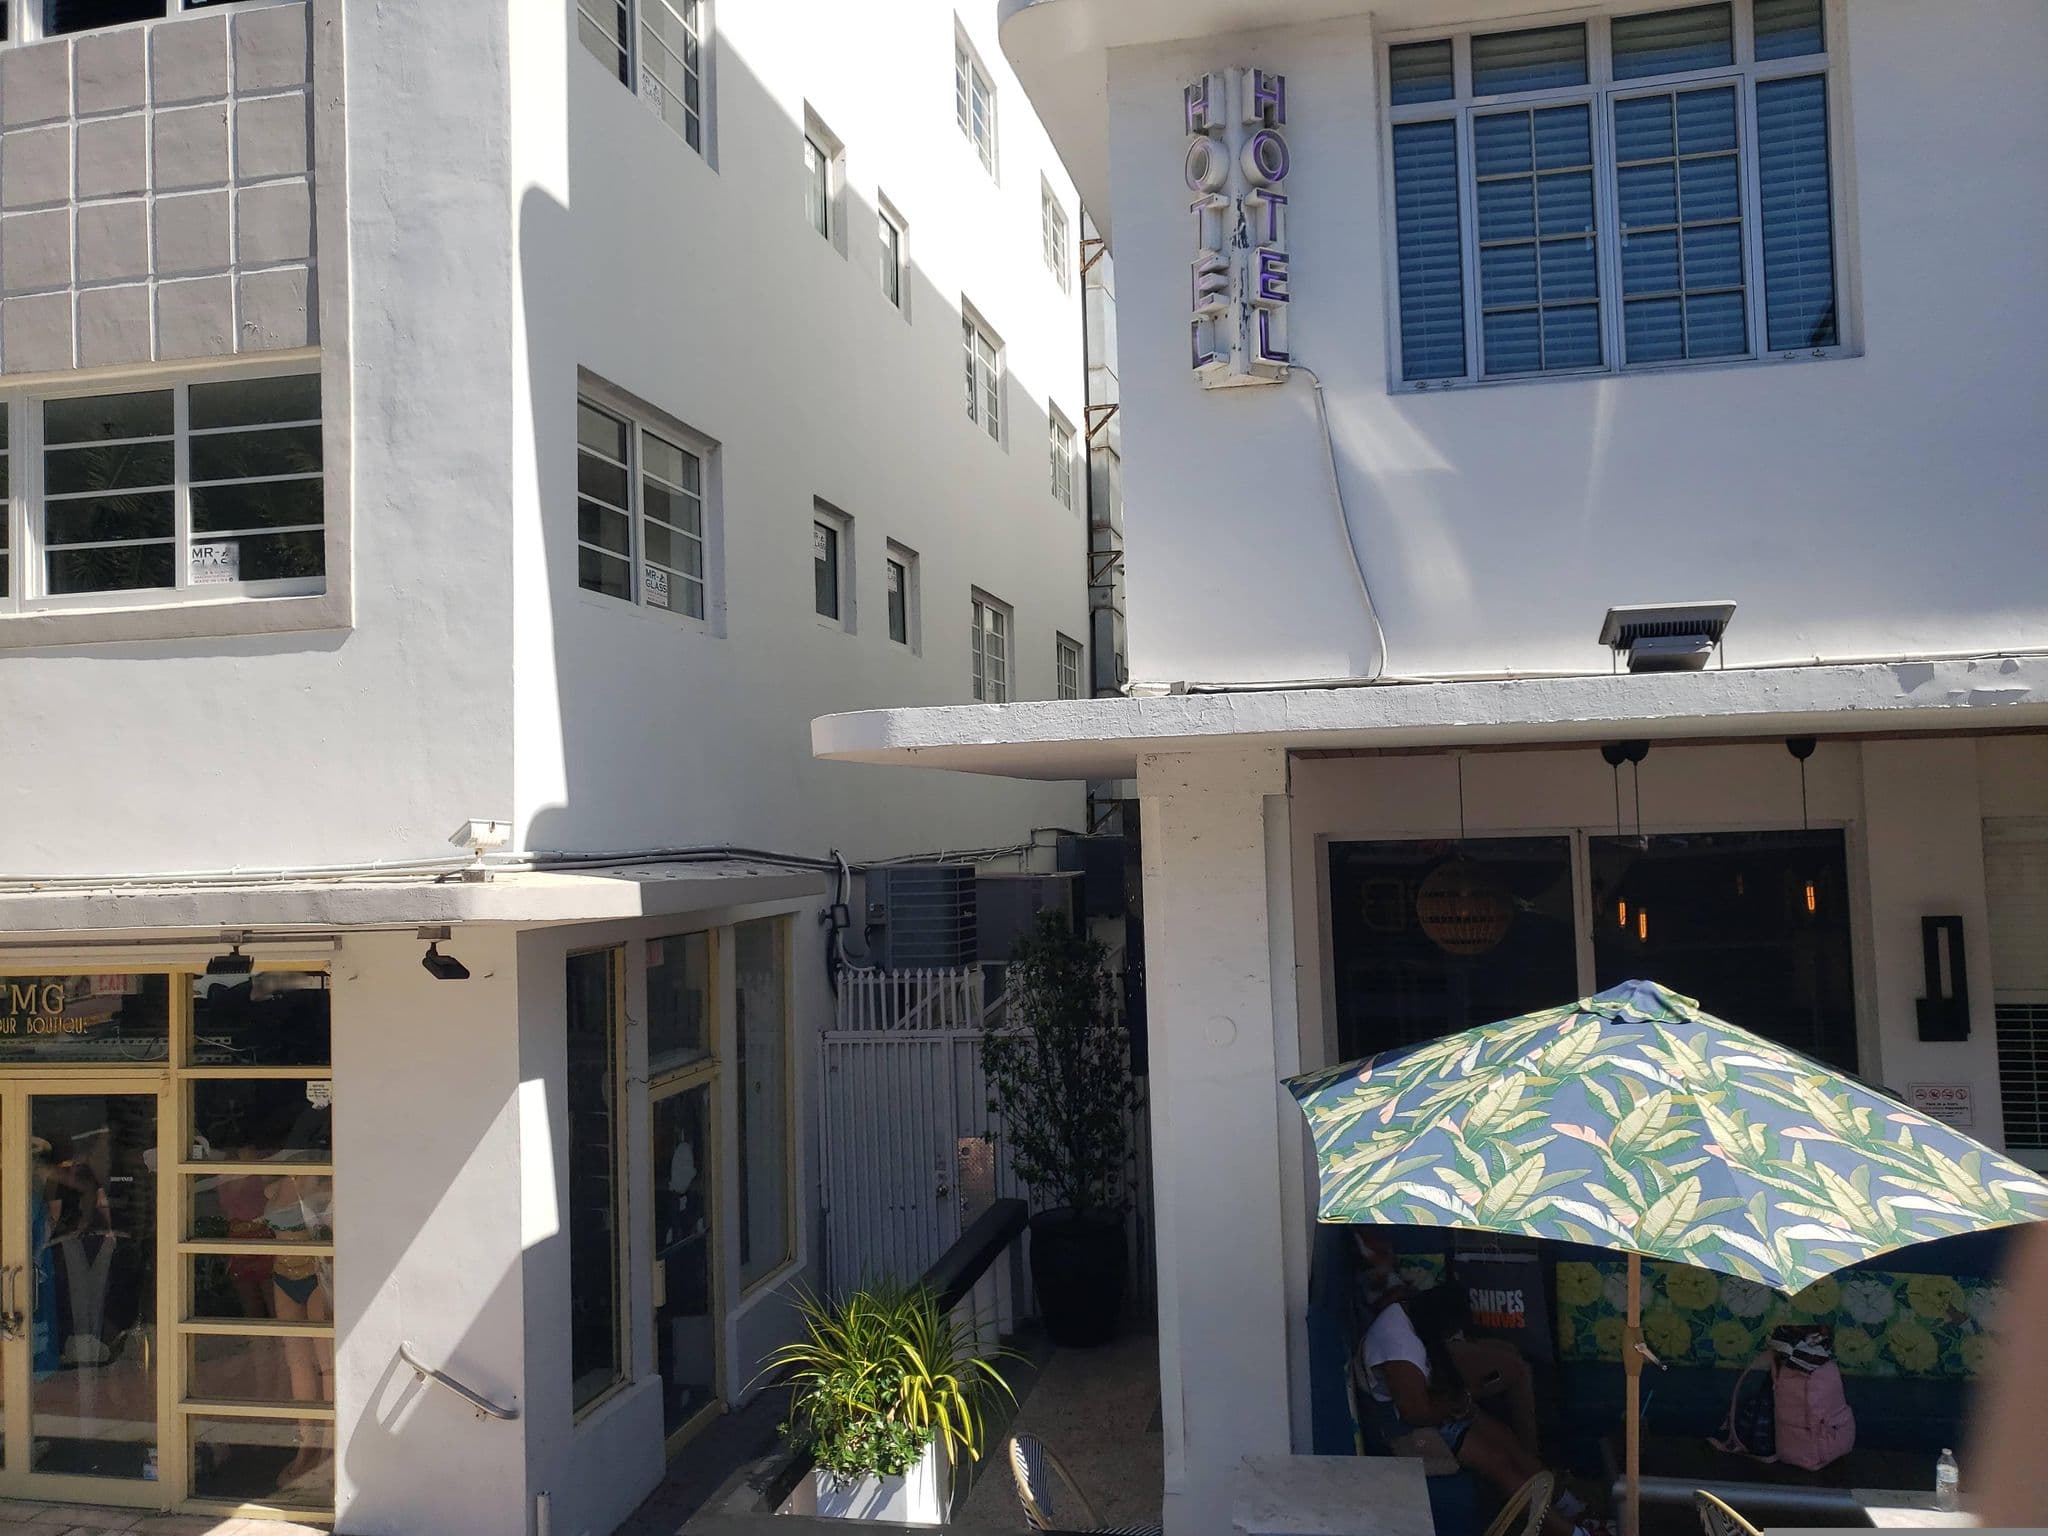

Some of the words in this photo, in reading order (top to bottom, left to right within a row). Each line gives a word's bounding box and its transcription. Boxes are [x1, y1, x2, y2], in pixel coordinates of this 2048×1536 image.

[1184, 71, 1225, 370] HOTEL
[1246, 67, 1290, 364] HOTEL
[1469, 1287, 1524, 1313] SNIPES
